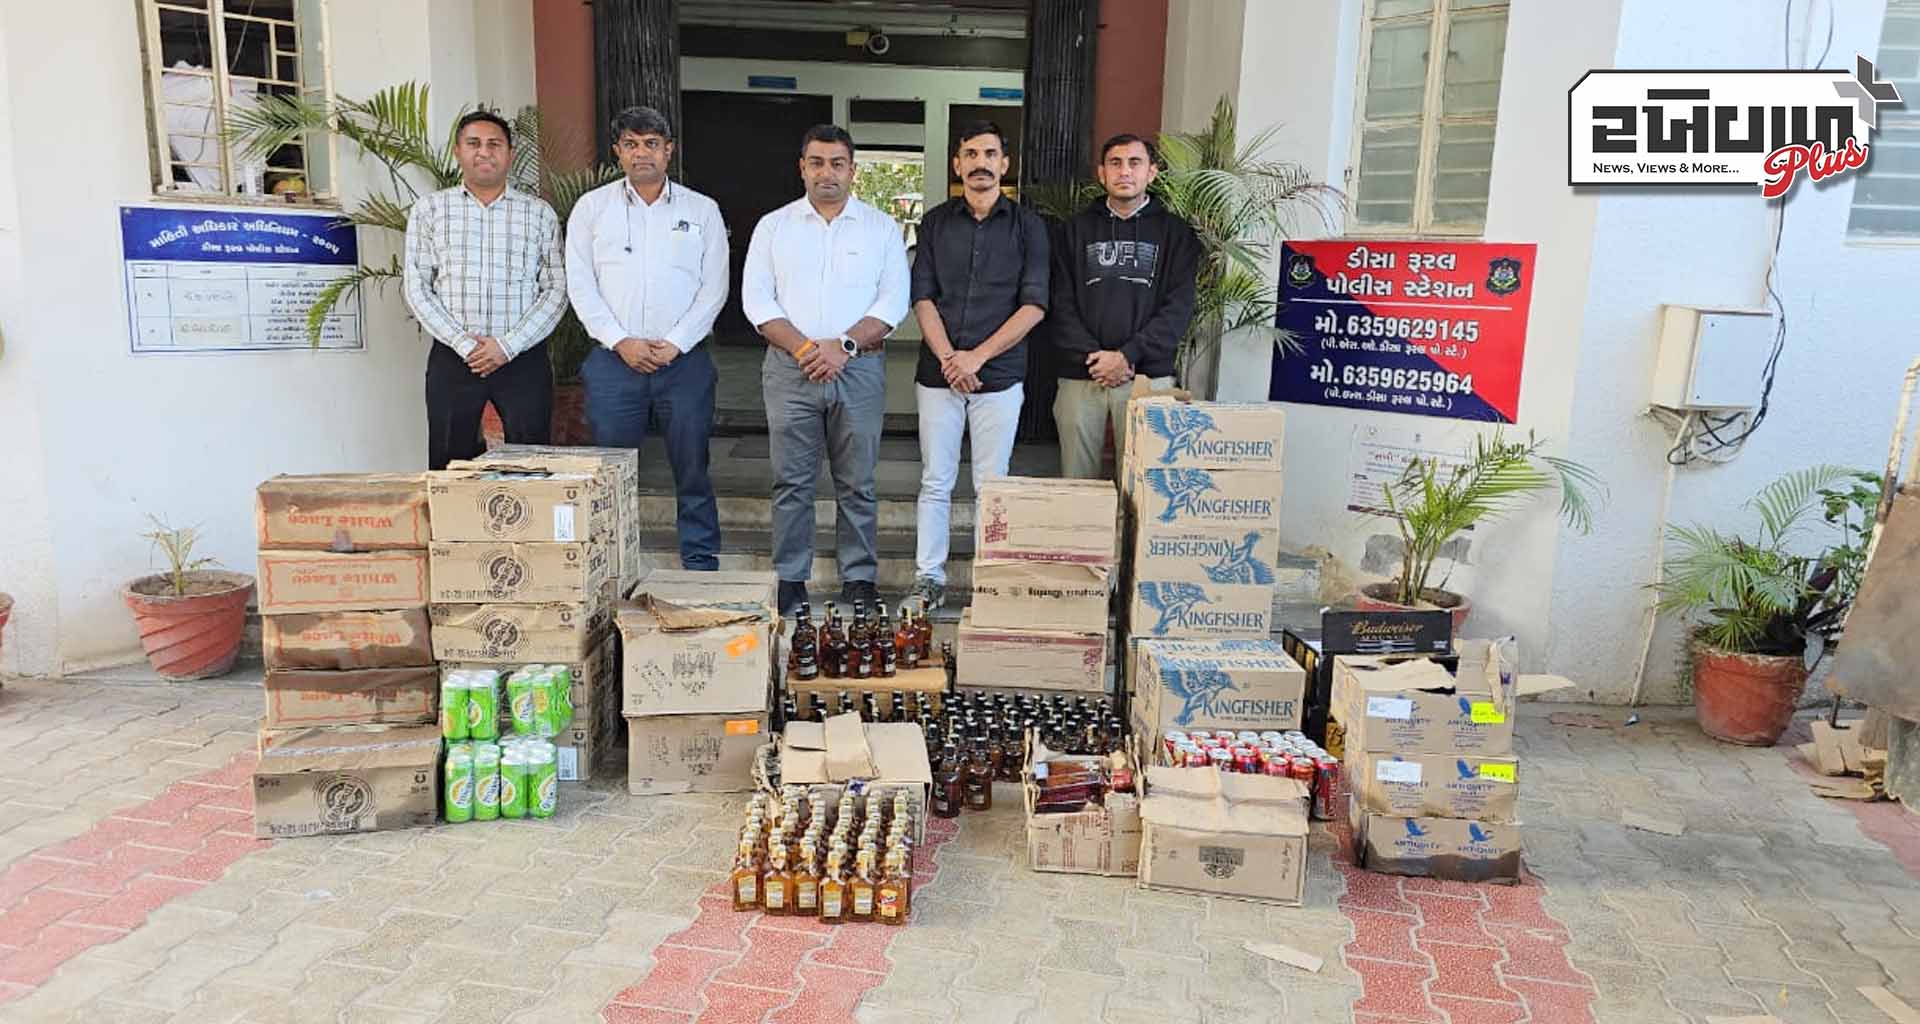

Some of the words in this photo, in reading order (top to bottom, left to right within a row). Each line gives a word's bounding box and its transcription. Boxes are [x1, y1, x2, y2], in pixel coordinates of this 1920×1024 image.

[150, 225, 188, 248] માહિતી
[1347, 246, 1395, 269] ડીસા
[1407, 249, 1456, 273] રૂરલ
[1326, 270, 1392, 296] પોલીસ
[1404, 275, 1474, 298] સ્ટેશન
[1186, 439, 1273, 458] KINGFISHER
[1185, 499, 1272, 517] KINGFISHER
[1151, 539, 1234, 556] KINGFISHER
[1177, 611, 1264, 629] KINGFISHER
[1351, 619, 1424, 635] Budweiser
[1202, 699, 1294, 718] KINGFISHER
